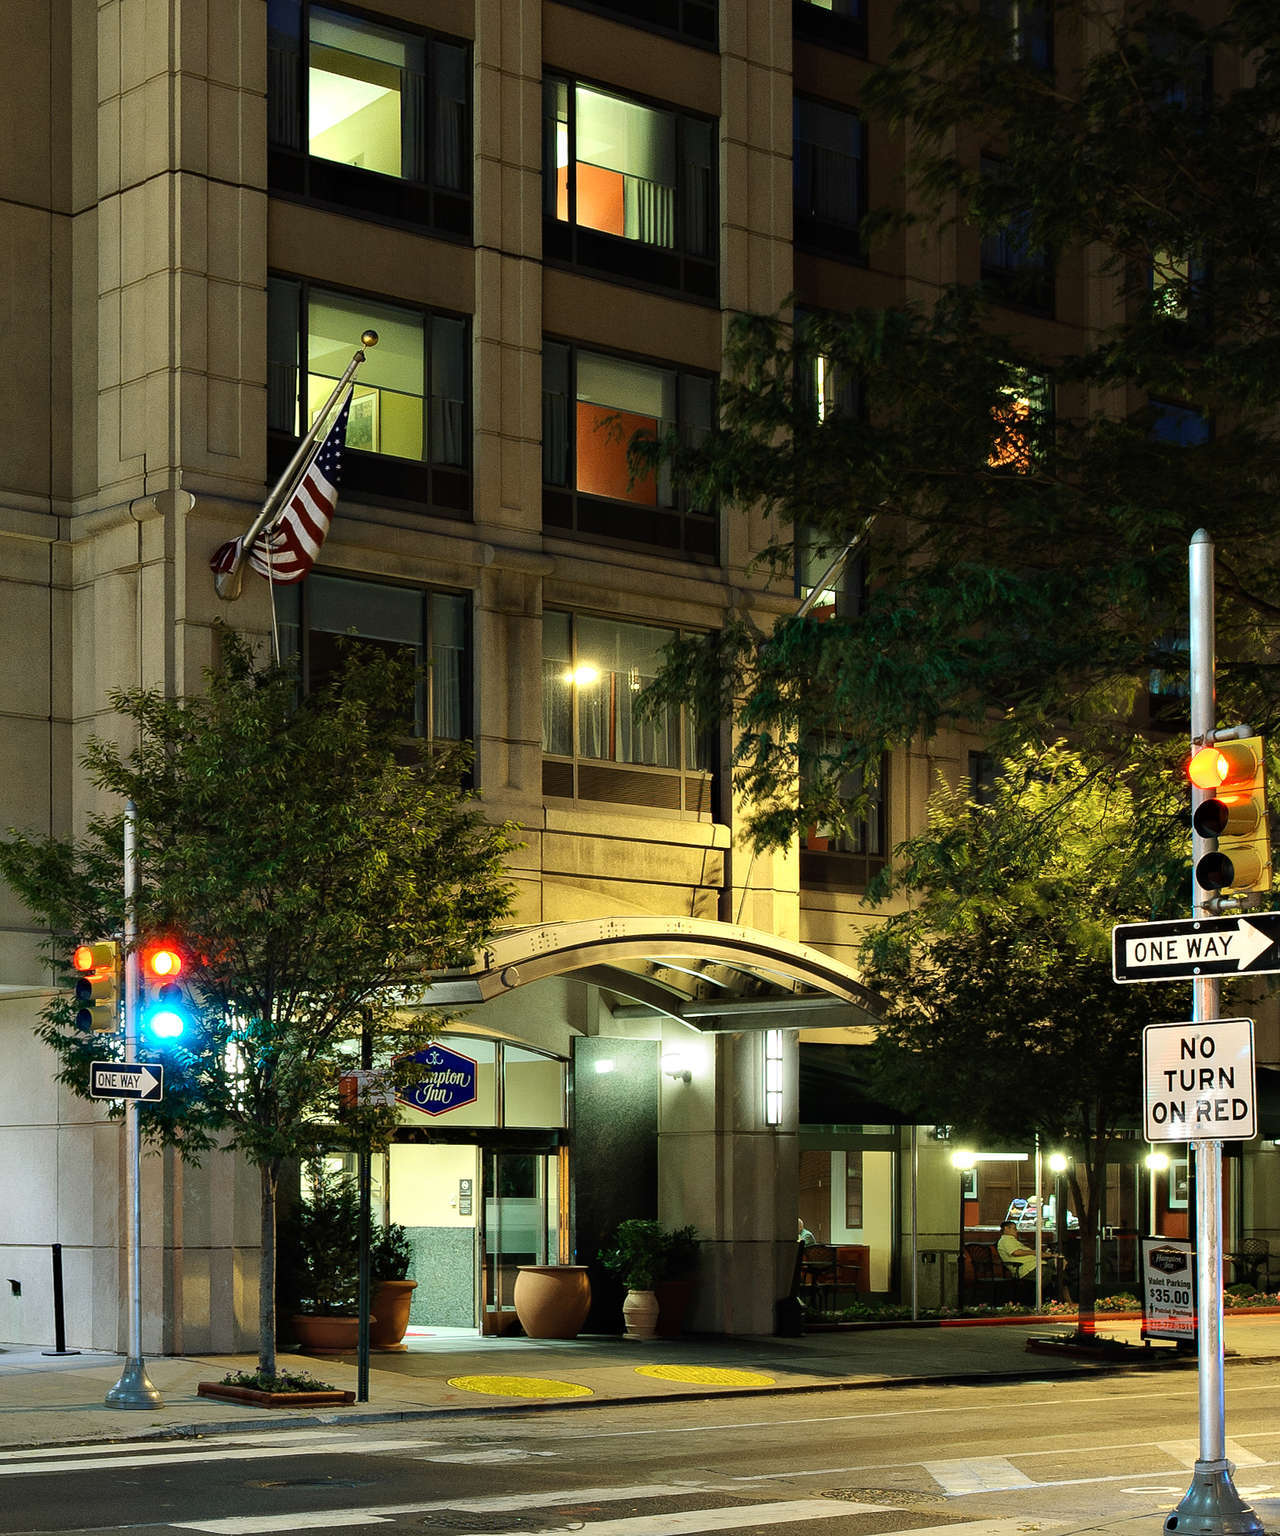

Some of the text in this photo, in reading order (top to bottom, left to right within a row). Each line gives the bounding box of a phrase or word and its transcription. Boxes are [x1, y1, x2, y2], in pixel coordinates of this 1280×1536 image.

[1134, 935, 1233, 963] ONE WAY
[1180, 1036, 1216, 1060] NO
[98, 1073, 140, 1088] ONE WAY
[412, 1068, 471, 1088] mpton
[1163, 1066, 1235, 1092] TURN
[415, 1083, 453, 1104] Inn
[1152, 1098, 1249, 1124] ON RED
[1148, 1277, 1191, 1289] Valet Parking
[1150, 1288, 1189, 1305] $35.00
